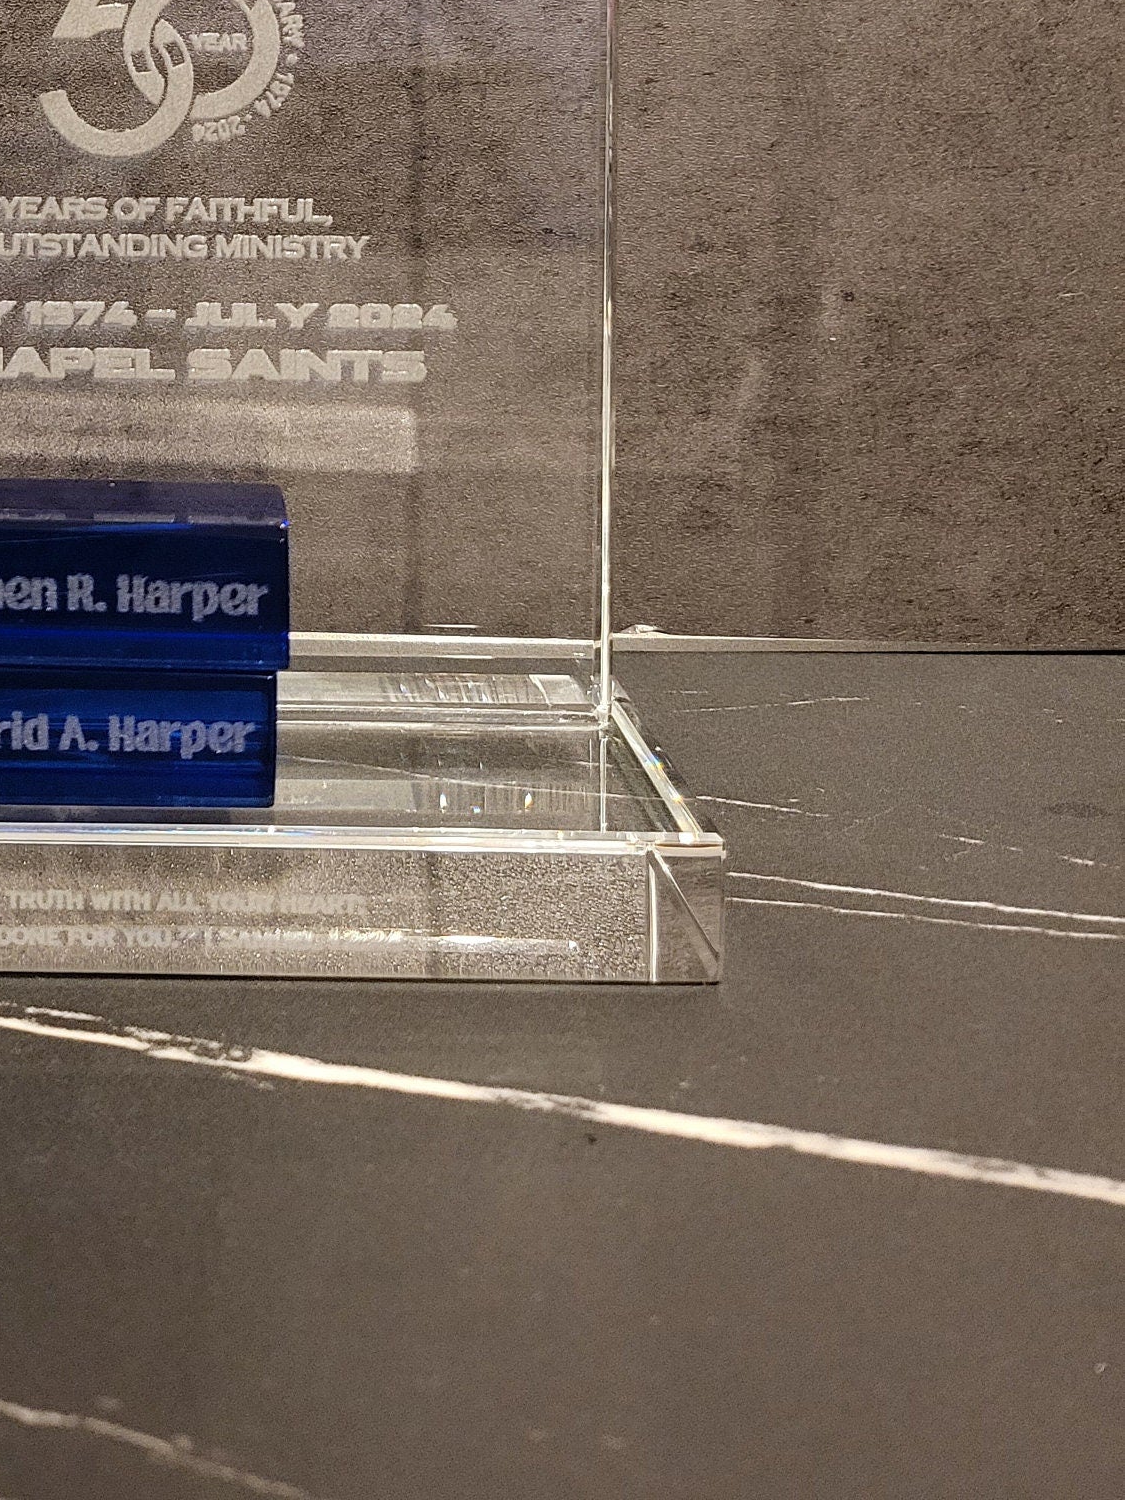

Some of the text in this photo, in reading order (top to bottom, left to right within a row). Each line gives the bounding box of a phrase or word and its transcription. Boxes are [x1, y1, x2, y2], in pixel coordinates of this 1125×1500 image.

[186, 31, 249, 52] YEAR
[114, 197, 161, 222] OF
[166, 196, 334, 226] FAITHFUL,
[216, 234, 371, 261] MINISTRY
[24, 300, 138, 328] 1974
[183, 302, 320, 330] JULY
[186, 348, 429, 384] SAINTS
[66, 573, 107, 613] R.
[115, 574, 270, 622] Harper
[59, 715, 99, 752] A.
[108, 715, 256, 761] Harper
